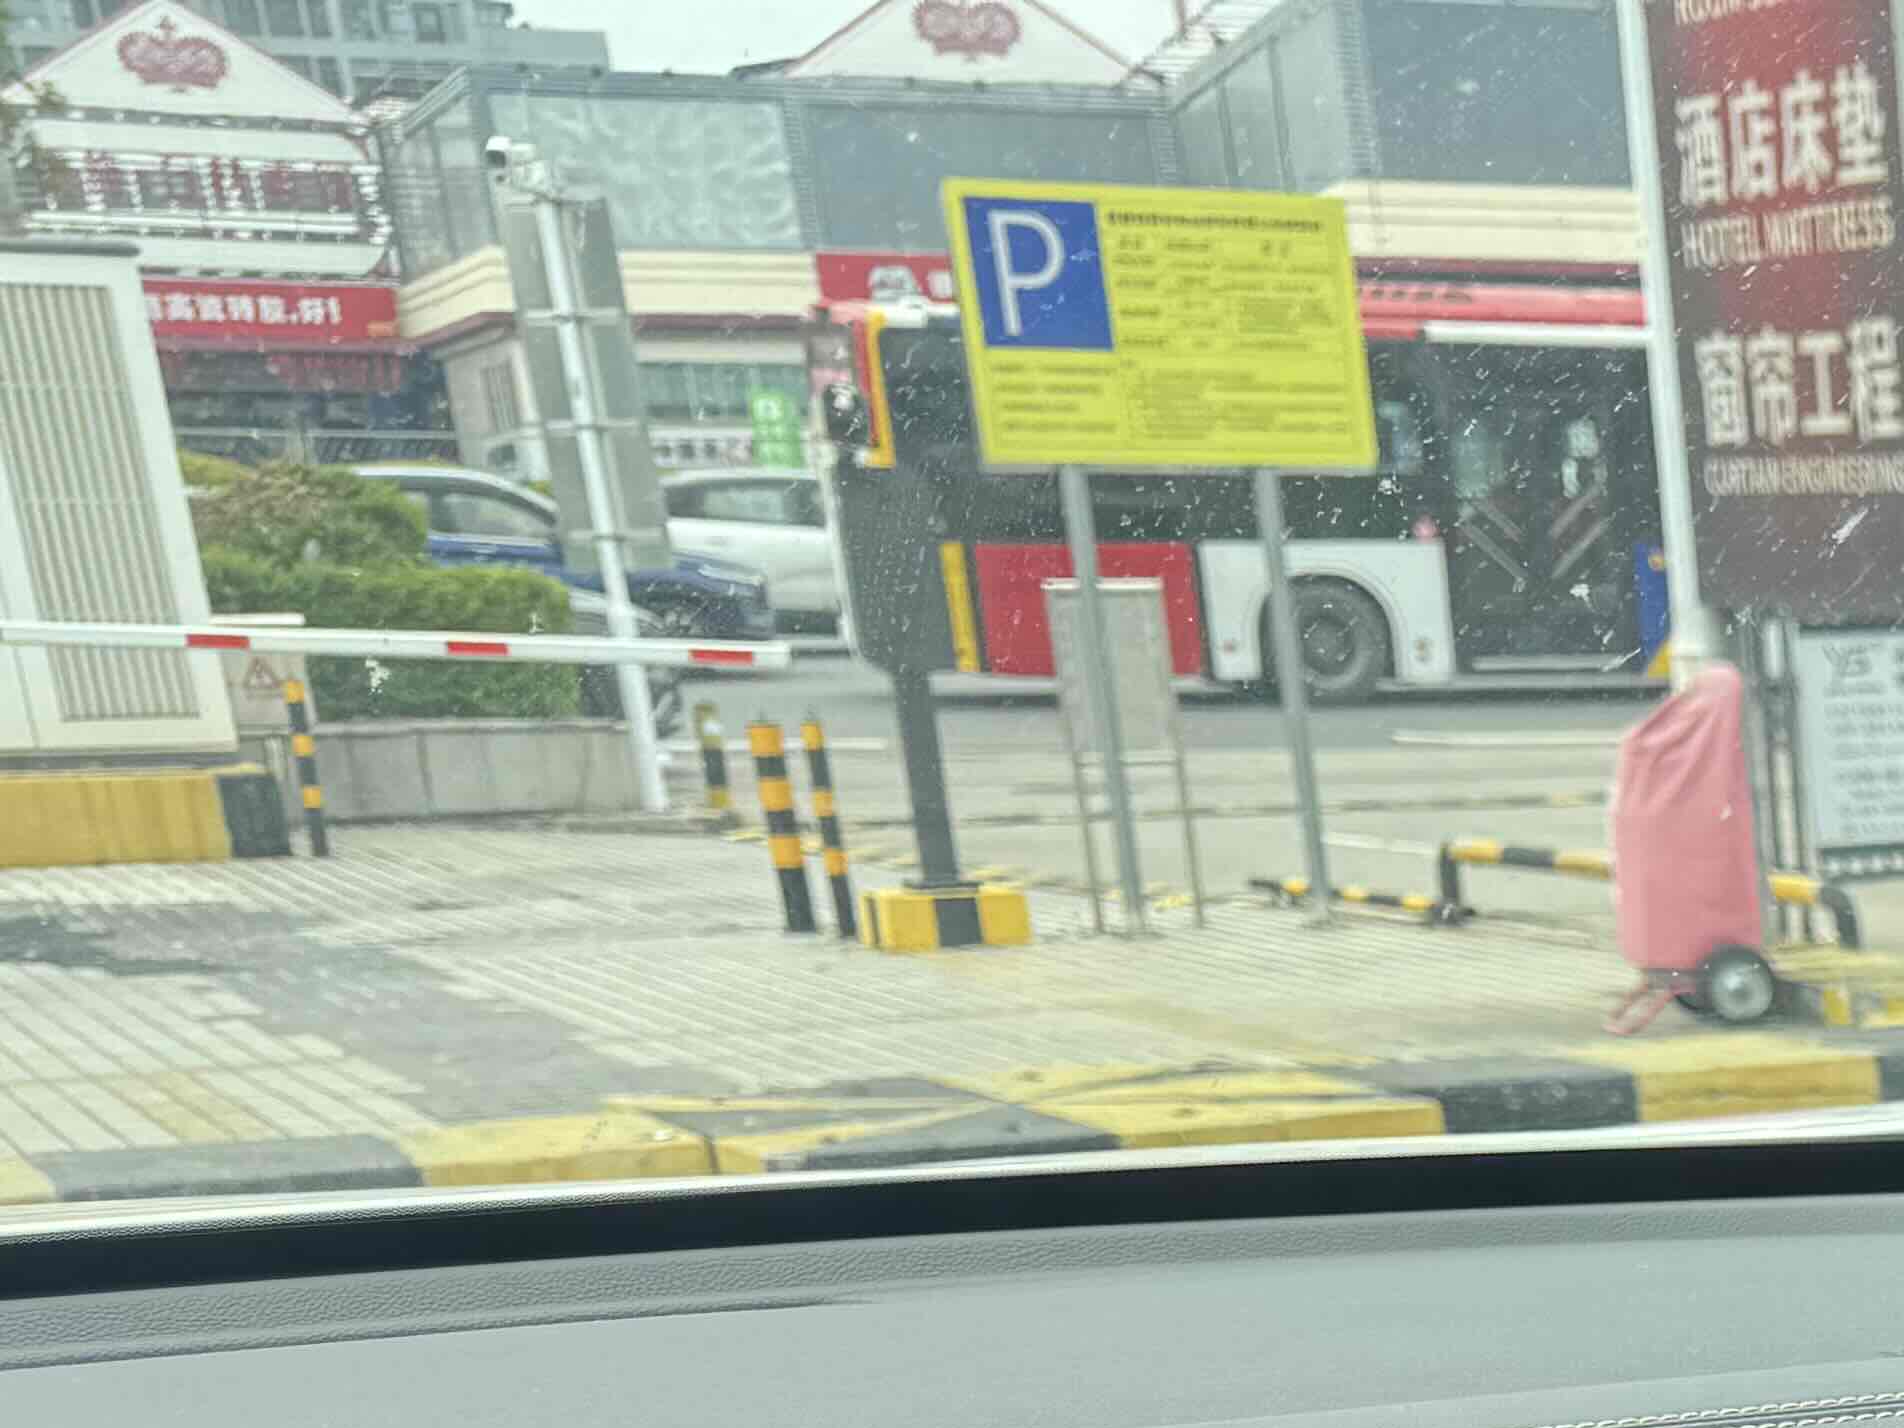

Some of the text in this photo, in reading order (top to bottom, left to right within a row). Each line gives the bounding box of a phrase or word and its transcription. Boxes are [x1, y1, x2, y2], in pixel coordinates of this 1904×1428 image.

[1675, 62, 1889, 205] 酒店床垫
[987, 209, 1065, 337] P
